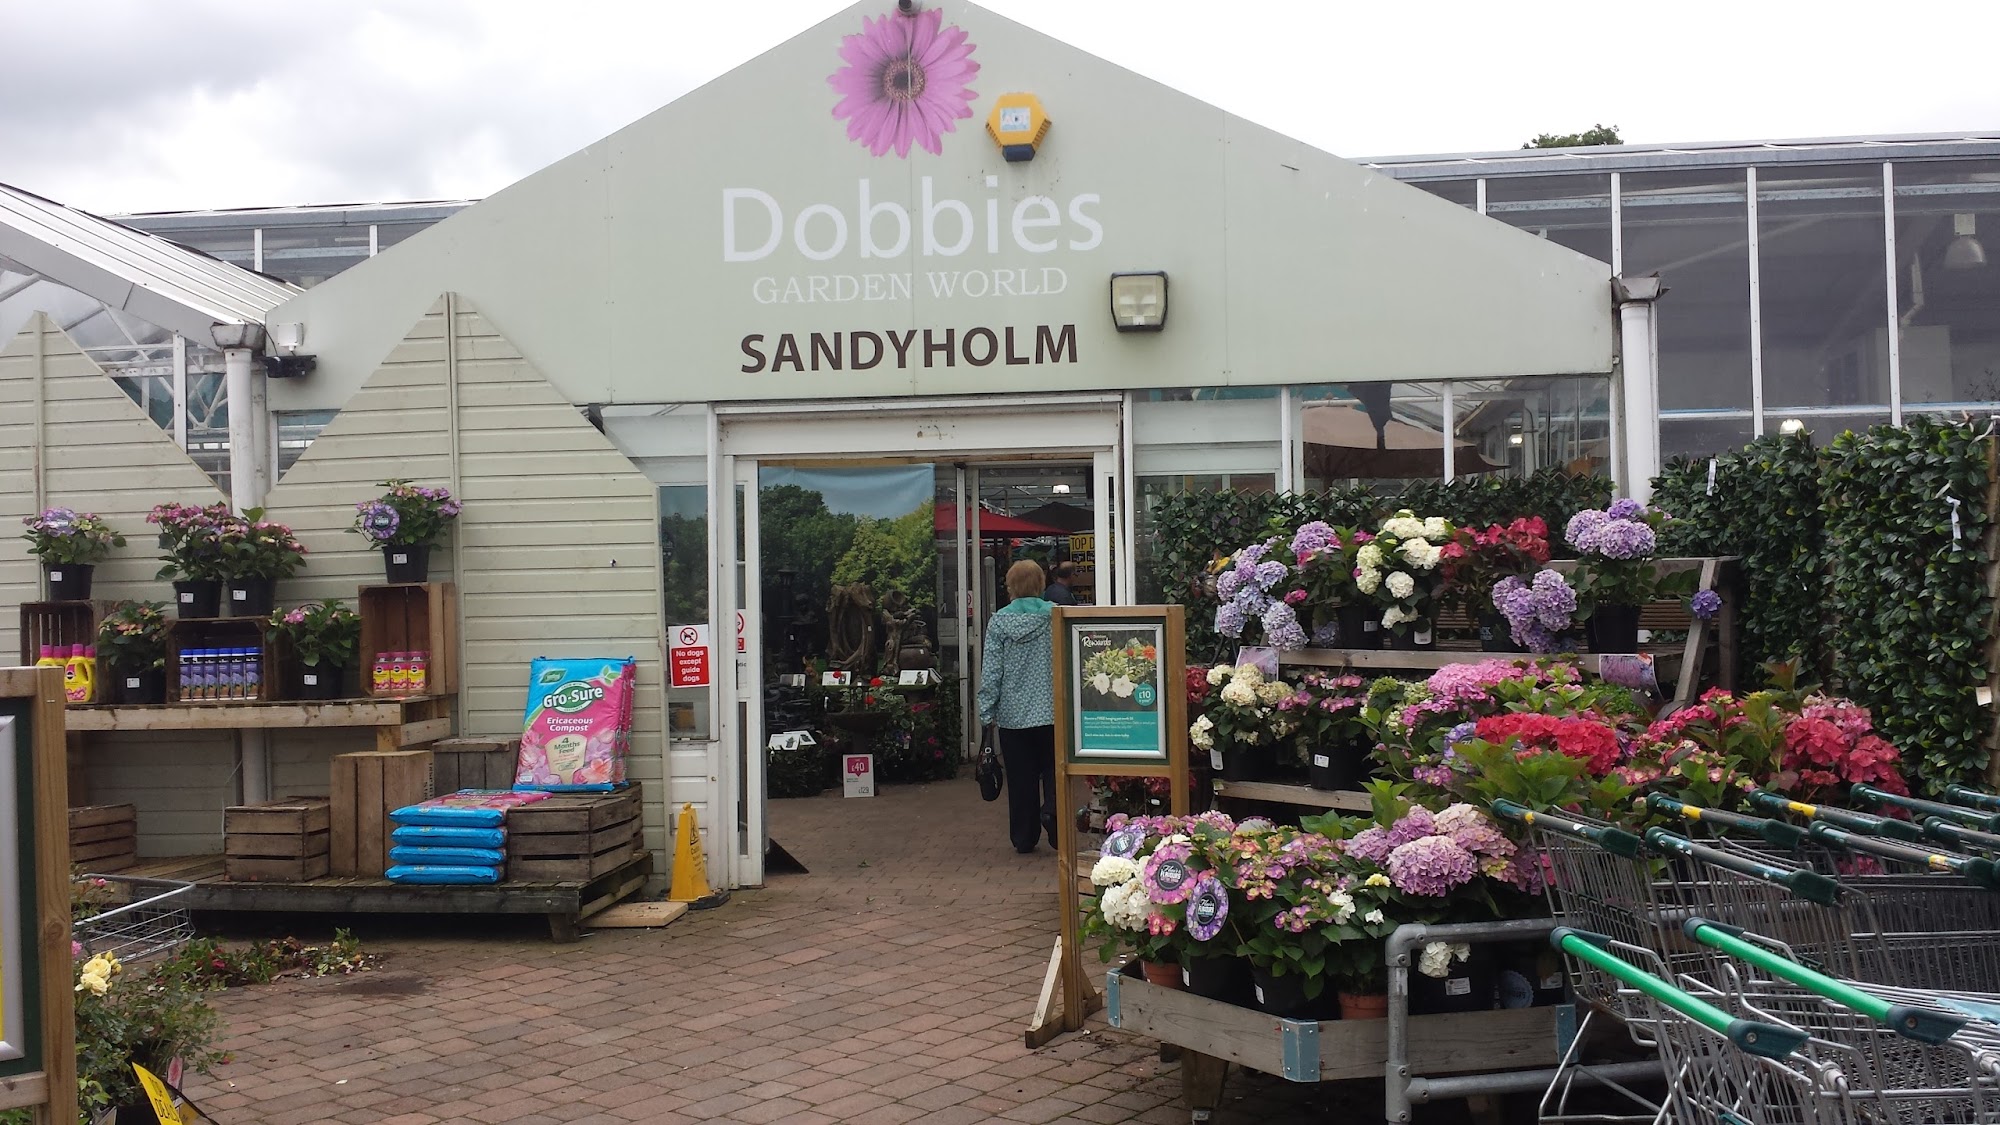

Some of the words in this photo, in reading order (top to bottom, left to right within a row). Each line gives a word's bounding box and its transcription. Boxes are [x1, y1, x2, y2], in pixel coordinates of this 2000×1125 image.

[722, 175, 1104, 262] Dobbies
[752, 272, 914, 304] GARDEN
[926, 266, 1069, 299] WORLD
[740, 323, 1079, 374] SANDYHOLM
[1071, 537, 1087, 550] TOP
[1082, 636, 1112, 647] Rewards
[687, 649, 704, 657] dogs
[679, 658, 702, 666] except
[543, 687, 603, 708] Gro-Sure
[546, 717, 594, 725] Ericaceous
[549, 724, 589, 733] Compost
